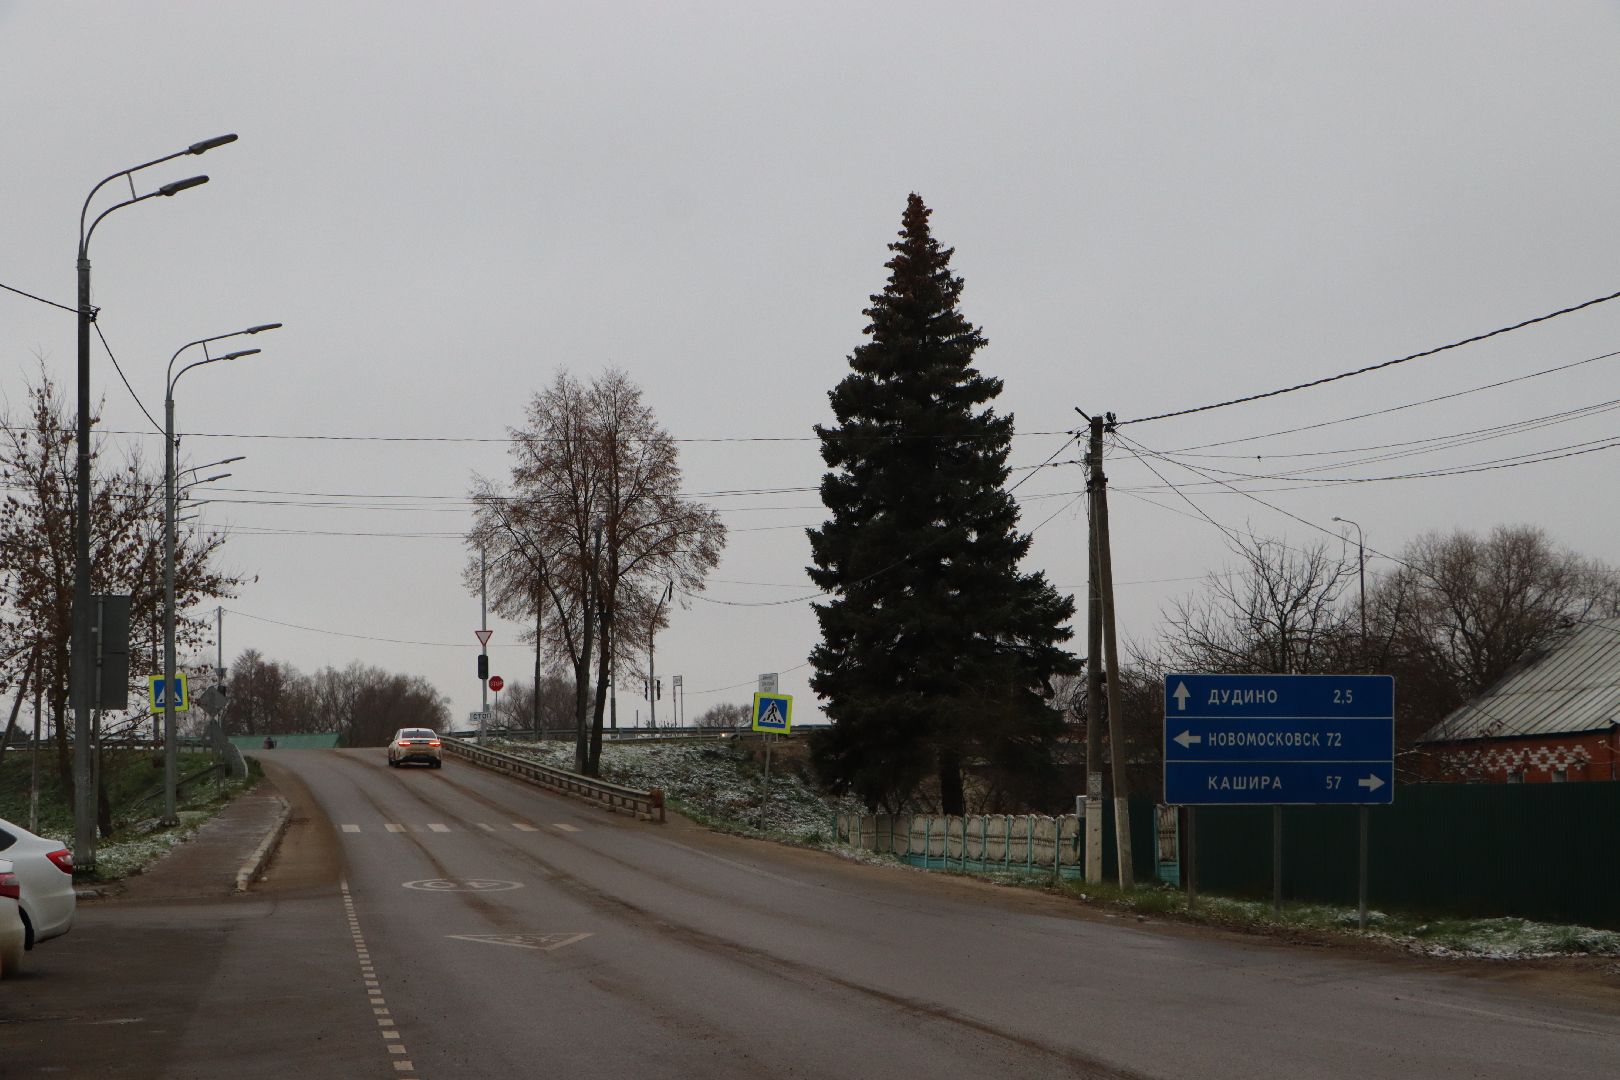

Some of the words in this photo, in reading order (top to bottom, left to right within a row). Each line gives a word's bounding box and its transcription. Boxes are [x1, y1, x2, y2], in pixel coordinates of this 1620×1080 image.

[1208, 690, 1278, 705] ДУДИНО
[1333, 690, 1353, 704] 2,5
[1208, 732, 1320, 746] НОВОМОСКОВСК
[1326, 733, 1342, 747] 72
[1208, 776, 1282, 790] КАШИРА
[1326, 776, 1342, 790] 57
